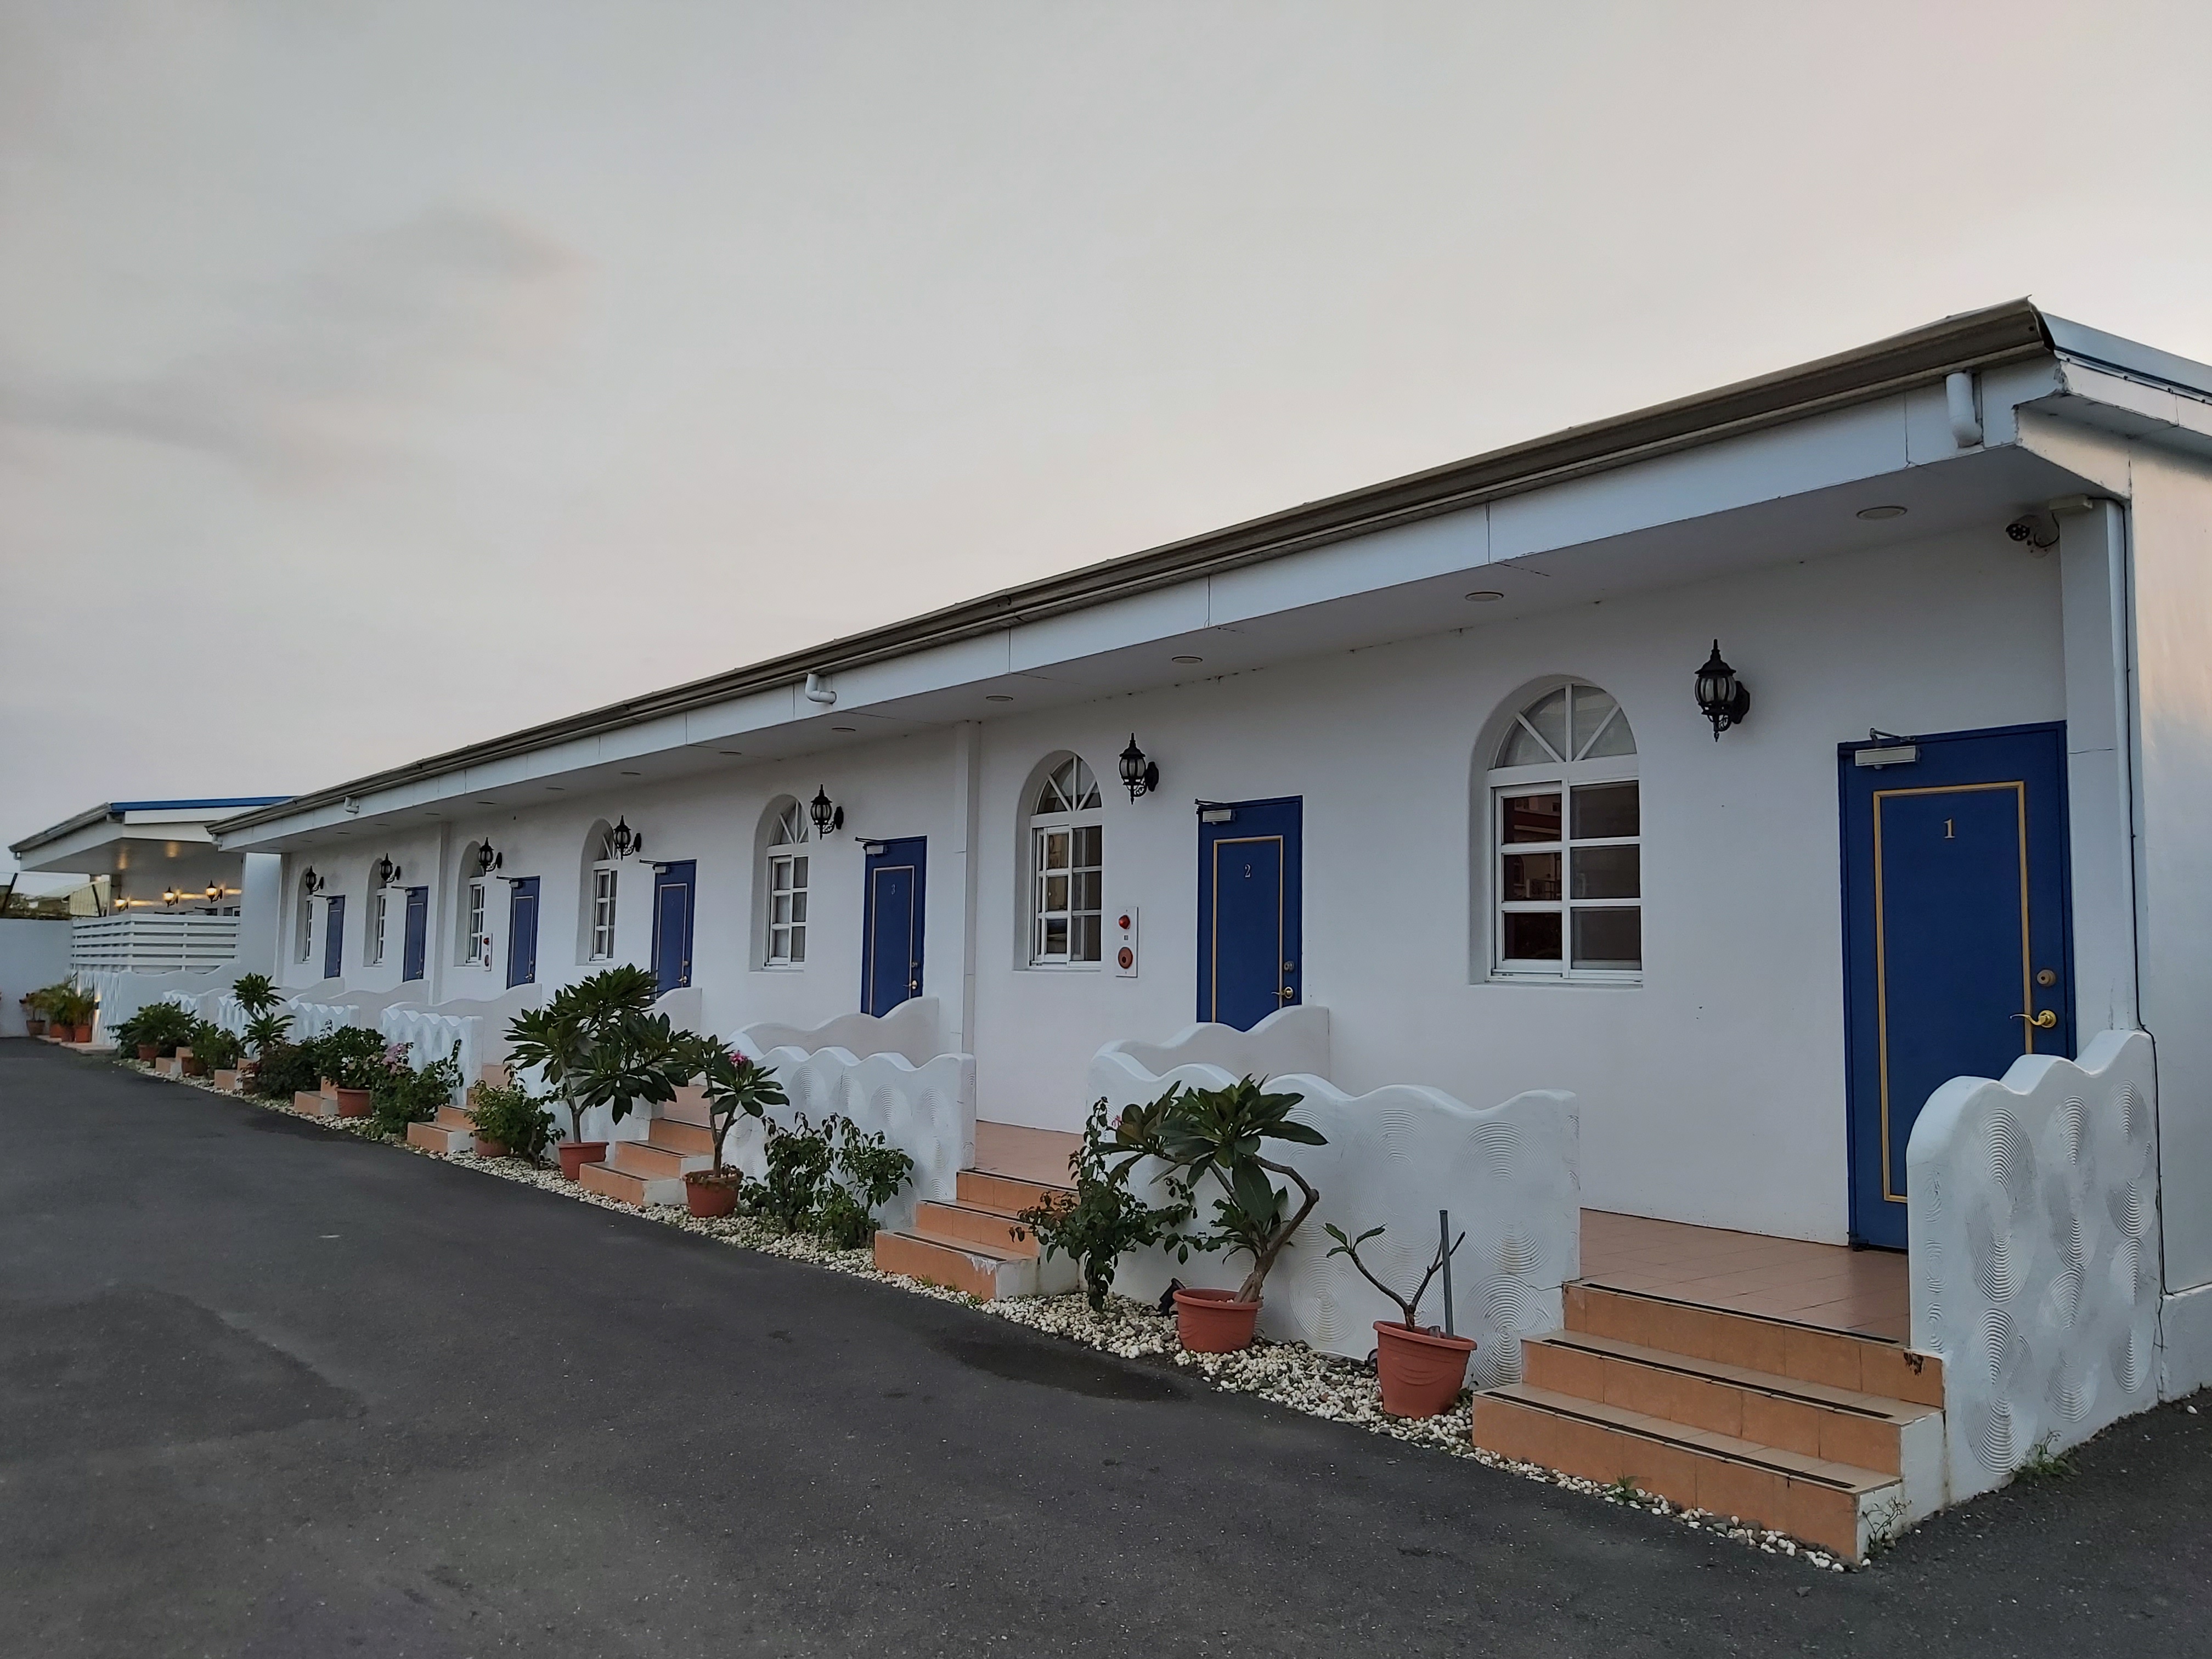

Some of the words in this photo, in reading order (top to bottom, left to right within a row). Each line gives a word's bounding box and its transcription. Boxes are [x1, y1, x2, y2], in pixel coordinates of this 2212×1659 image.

[1943, 819, 1955, 839] 1
[1245, 864, 1251, 878] 2
[891, 884, 896, 895] 3
